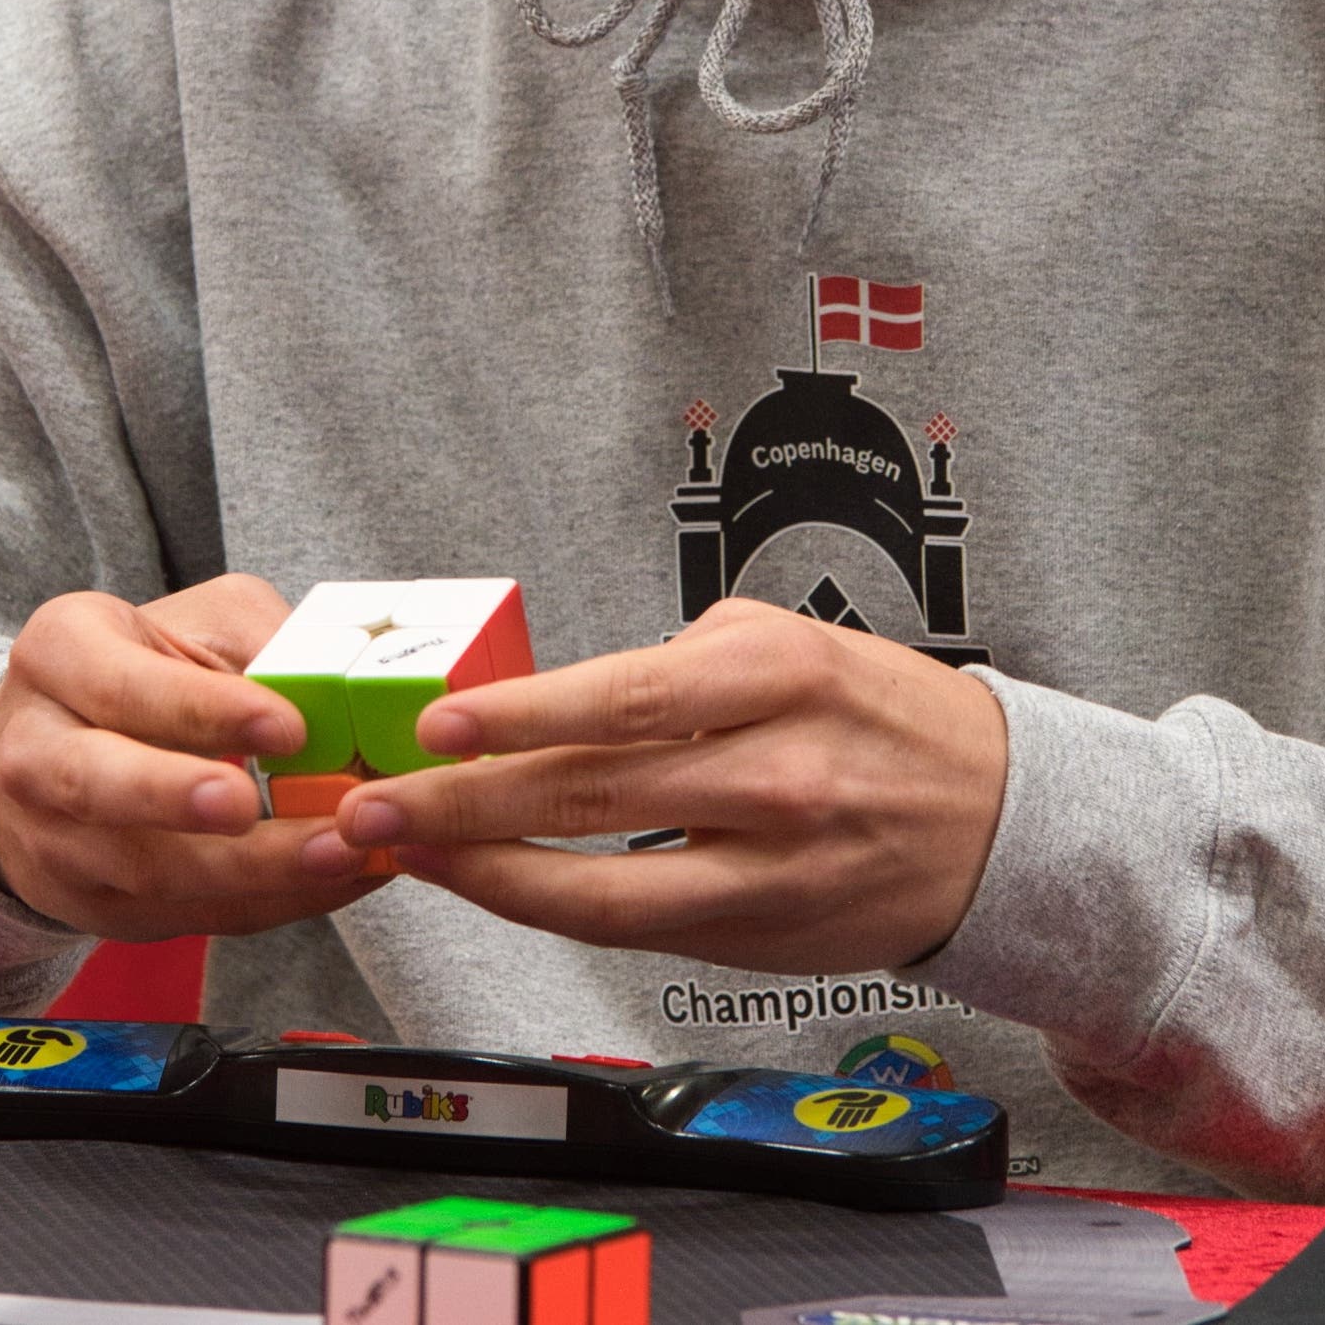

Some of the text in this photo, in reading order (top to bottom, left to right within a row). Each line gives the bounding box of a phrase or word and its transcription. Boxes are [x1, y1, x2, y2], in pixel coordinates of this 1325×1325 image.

[751, 437, 901, 482] Copenhagen
[662, 976, 973, 1032] Champions
[365, 1084, 469, 1123] Rubik's
